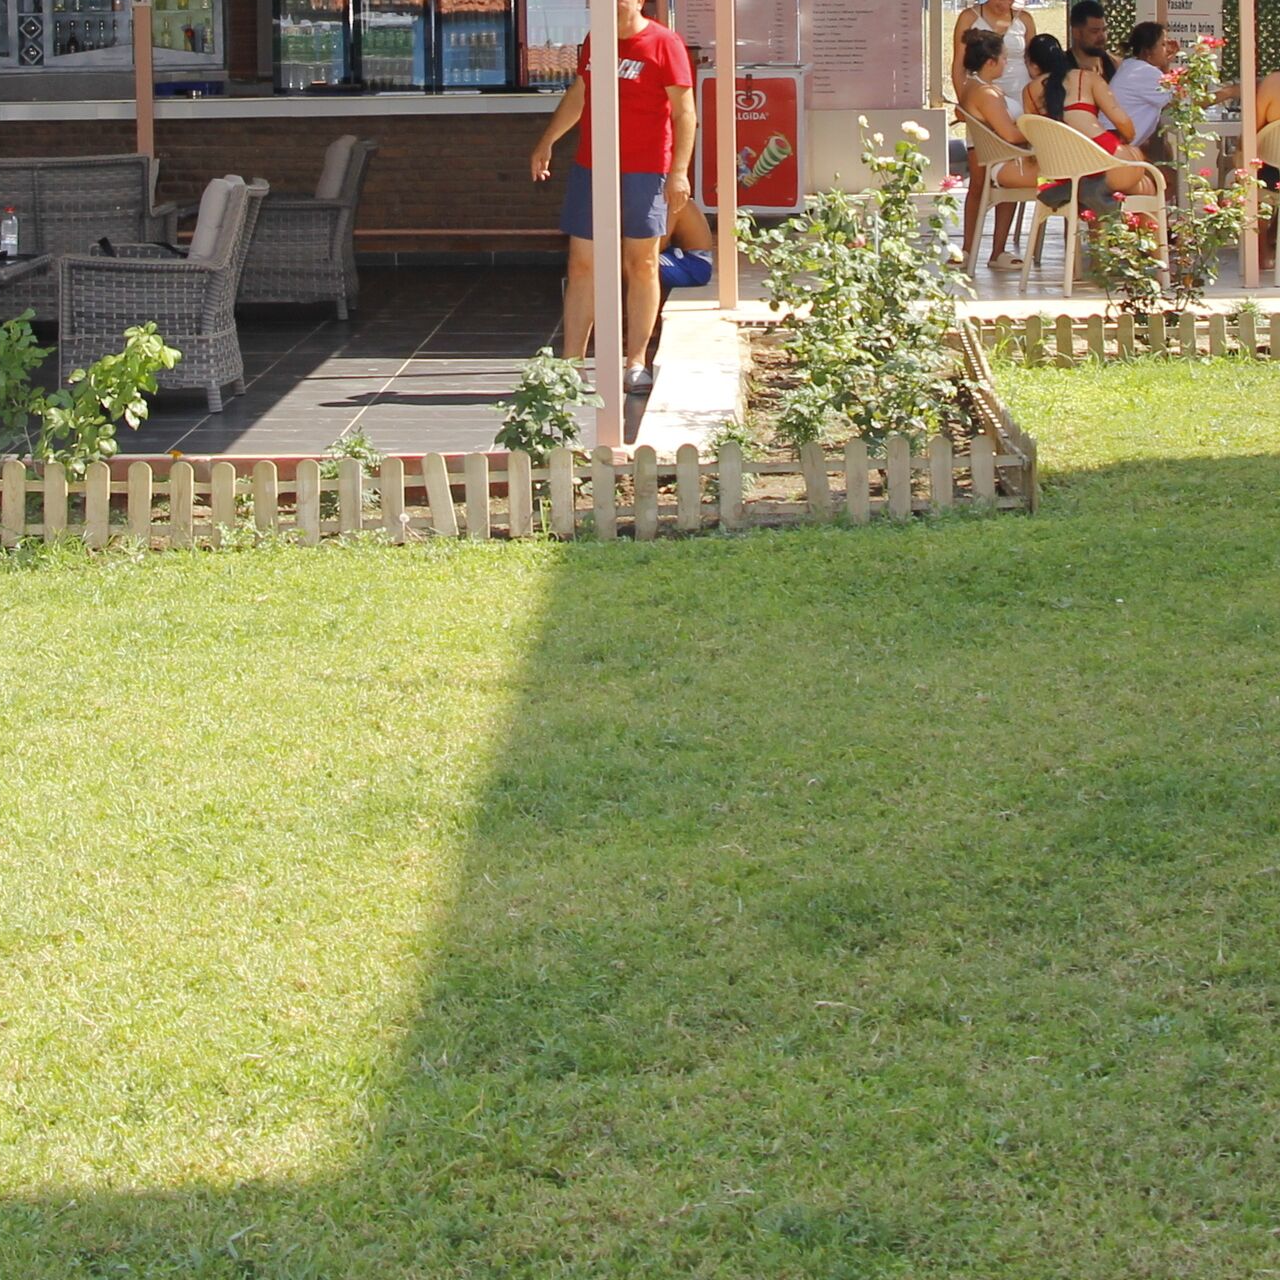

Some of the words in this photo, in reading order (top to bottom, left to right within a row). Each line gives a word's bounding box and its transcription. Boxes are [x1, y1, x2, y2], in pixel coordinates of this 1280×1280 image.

[1190, 23, 1197, 32] to
[1198, 21, 1215, 36] bring
[736, 111, 767, 121] LGIDA
